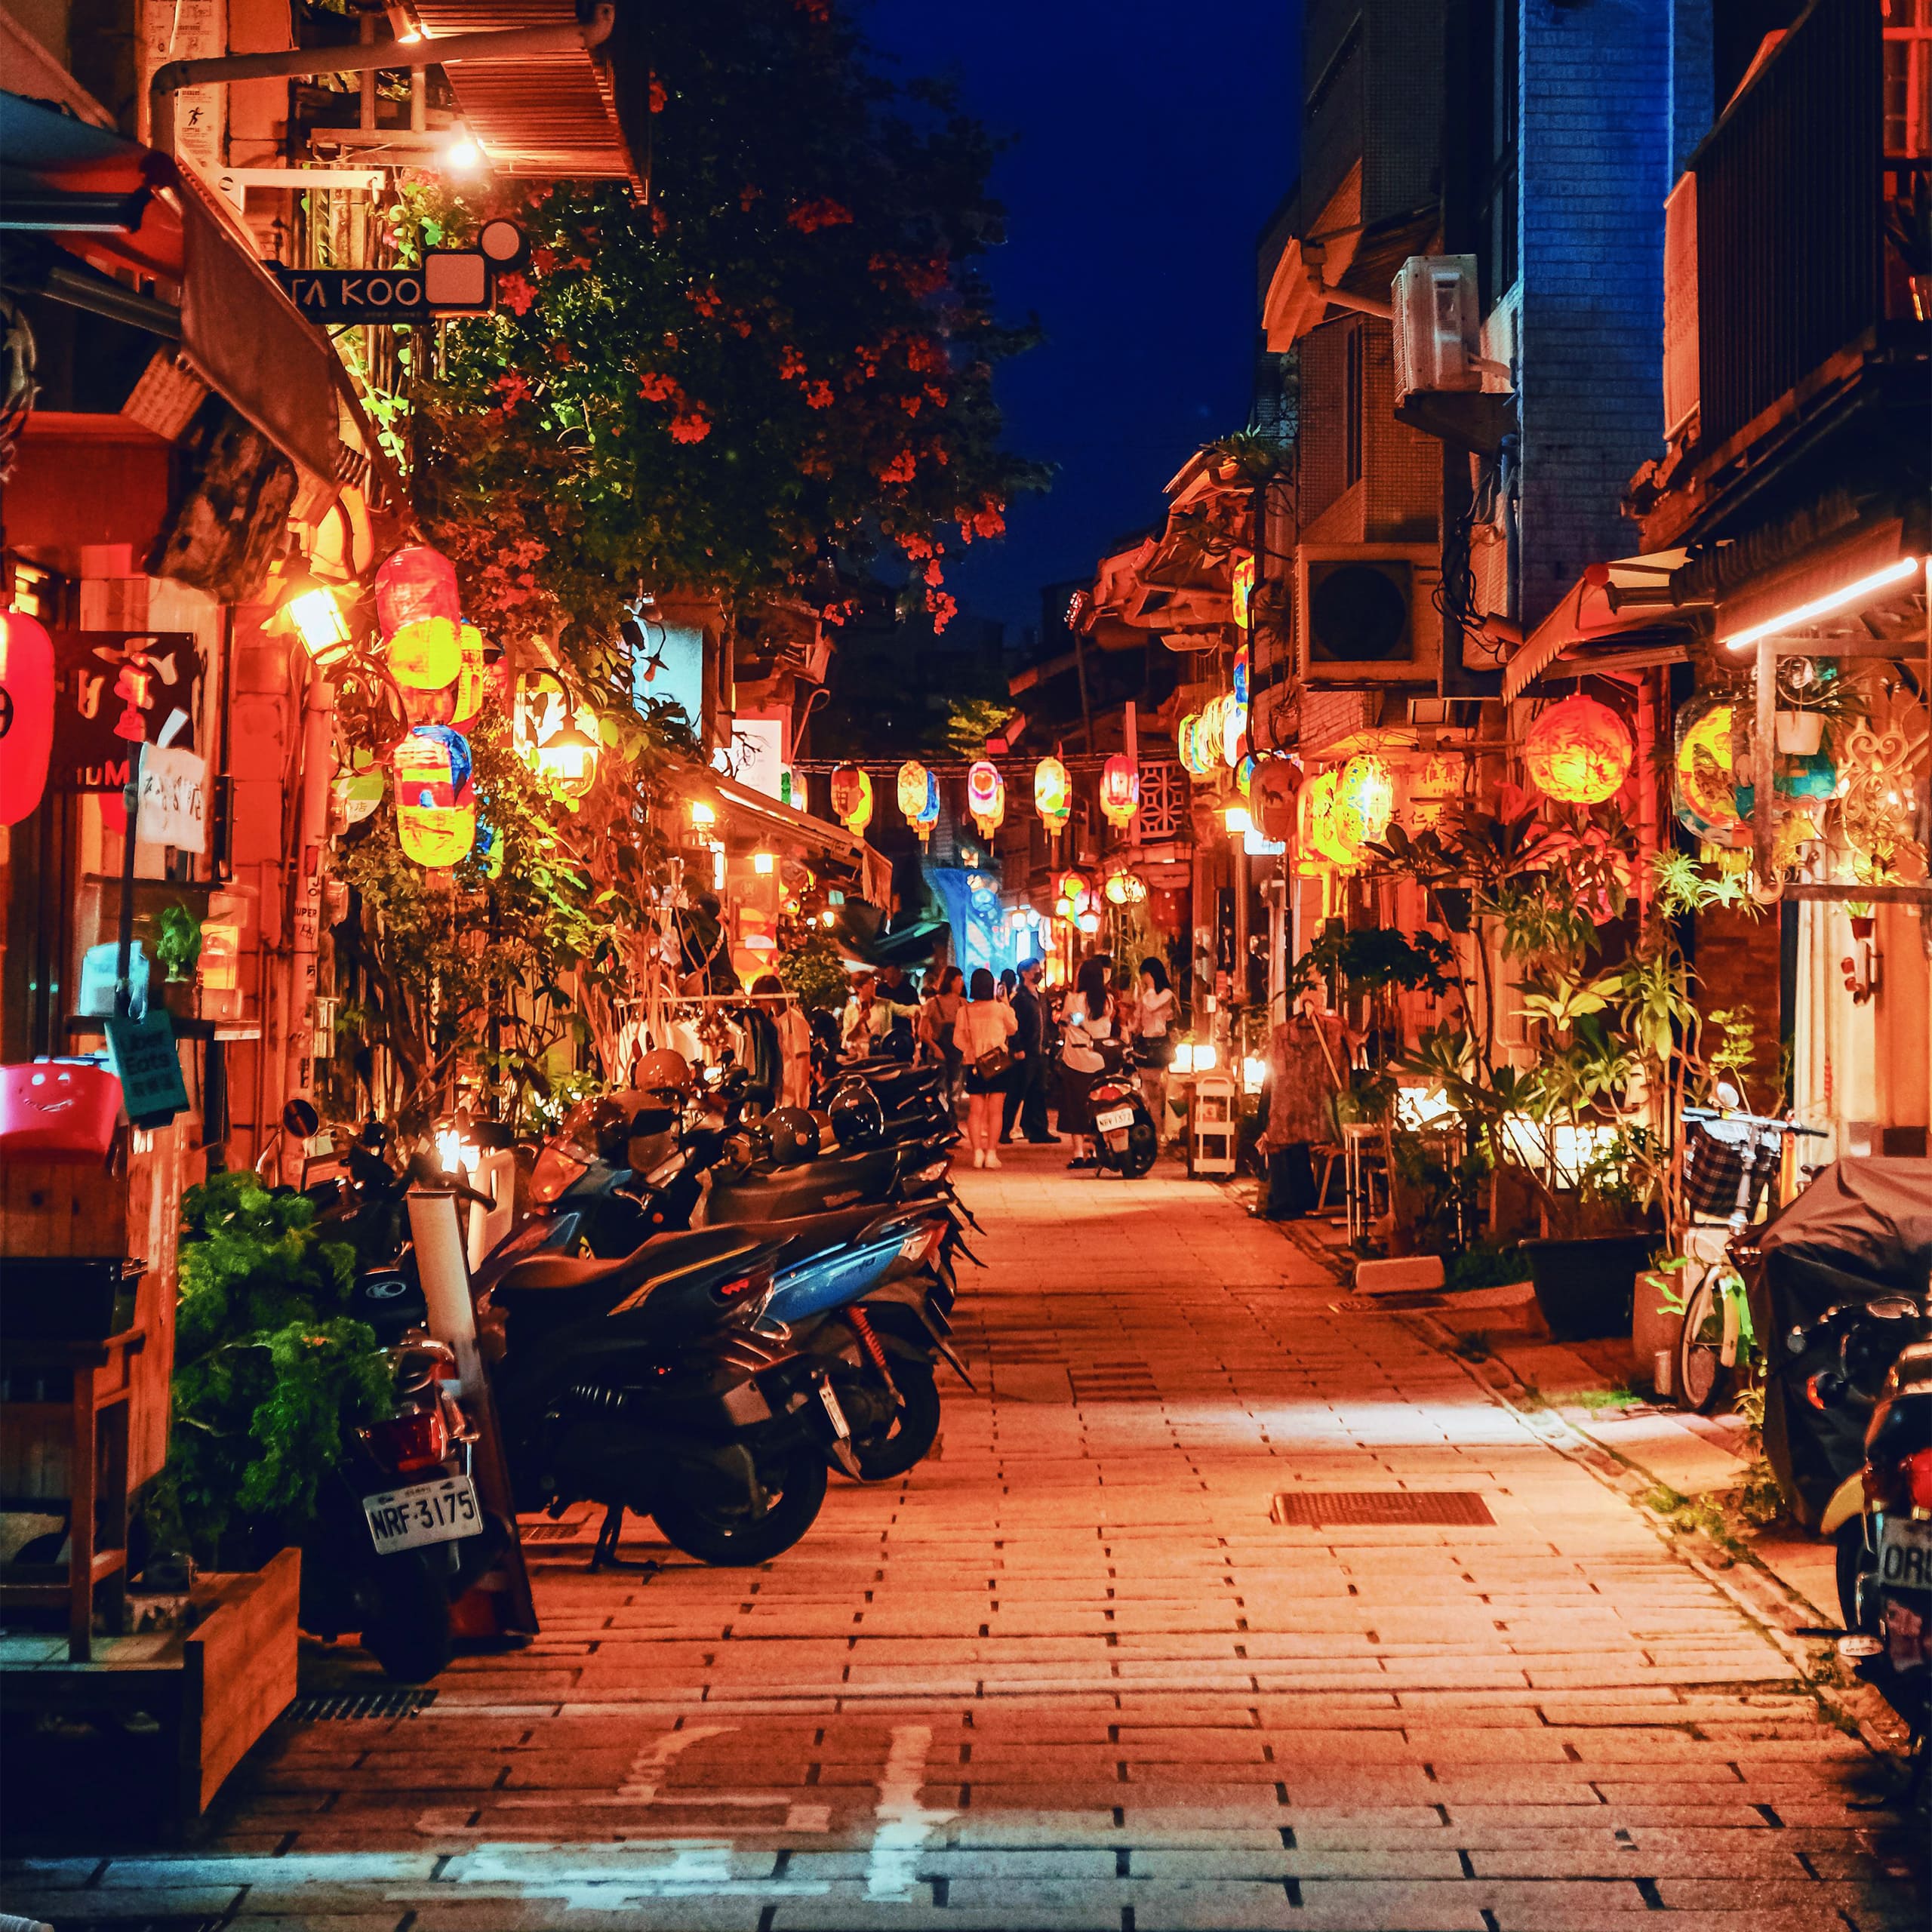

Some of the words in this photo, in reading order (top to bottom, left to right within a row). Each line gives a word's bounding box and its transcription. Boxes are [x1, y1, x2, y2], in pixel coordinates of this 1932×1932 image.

[341, 278, 422, 306] KOO
[296, 908, 317, 918] UPER
[125, 1053, 171, 1075] Eats
[370, 1491, 475, 1540] NRF-3175
